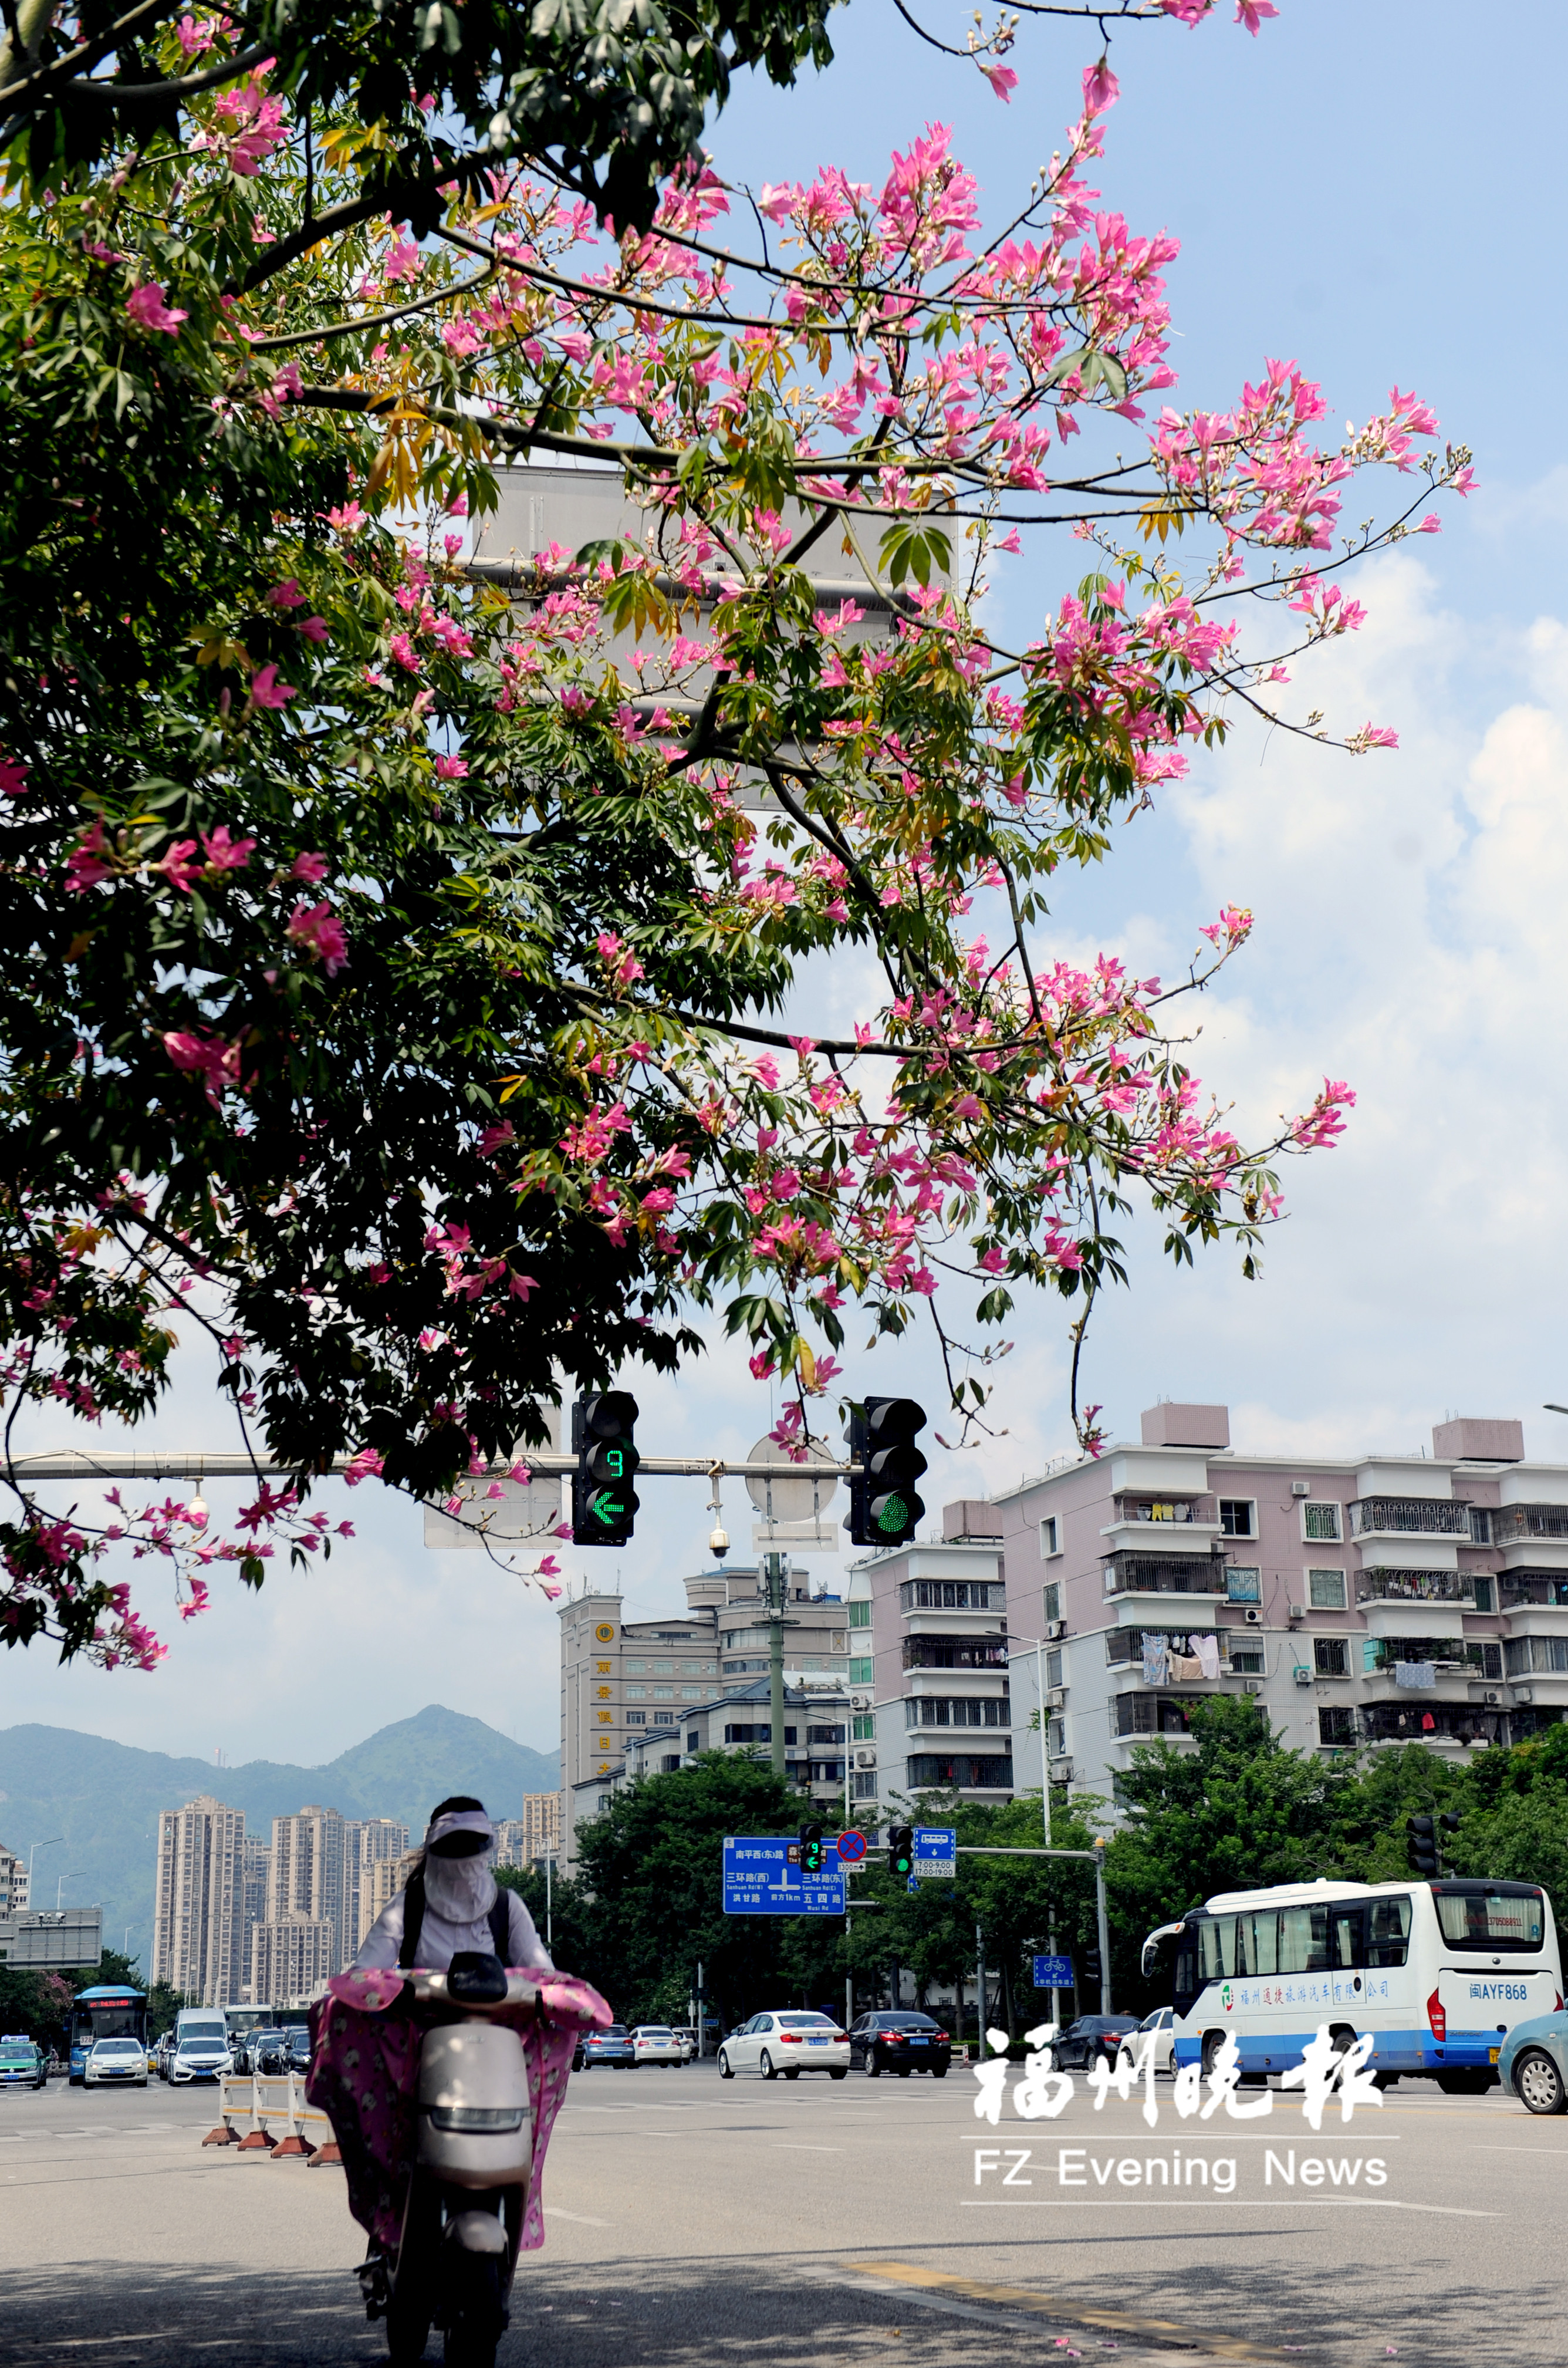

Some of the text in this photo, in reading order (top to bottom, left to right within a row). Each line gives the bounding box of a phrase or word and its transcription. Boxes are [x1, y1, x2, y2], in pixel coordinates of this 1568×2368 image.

[607, 1450, 623, 1477] 9
[812, 1843, 819, 1853] 9
[735, 1850, 784, 1860] 南平西(东)路
[726, 1873, 769, 1883] 三环路(西)
[802, 1873, 843, 1884] 三环路(东)
[733, 1894, 761, 1903] 洪甘路
[803, 1893, 842, 1904] 五四路
[1241, 1981, 1389, 2005] 福州通捷旅游汽车有限公司
[1469, 1983, 1528, 2000] 闽AYF868
